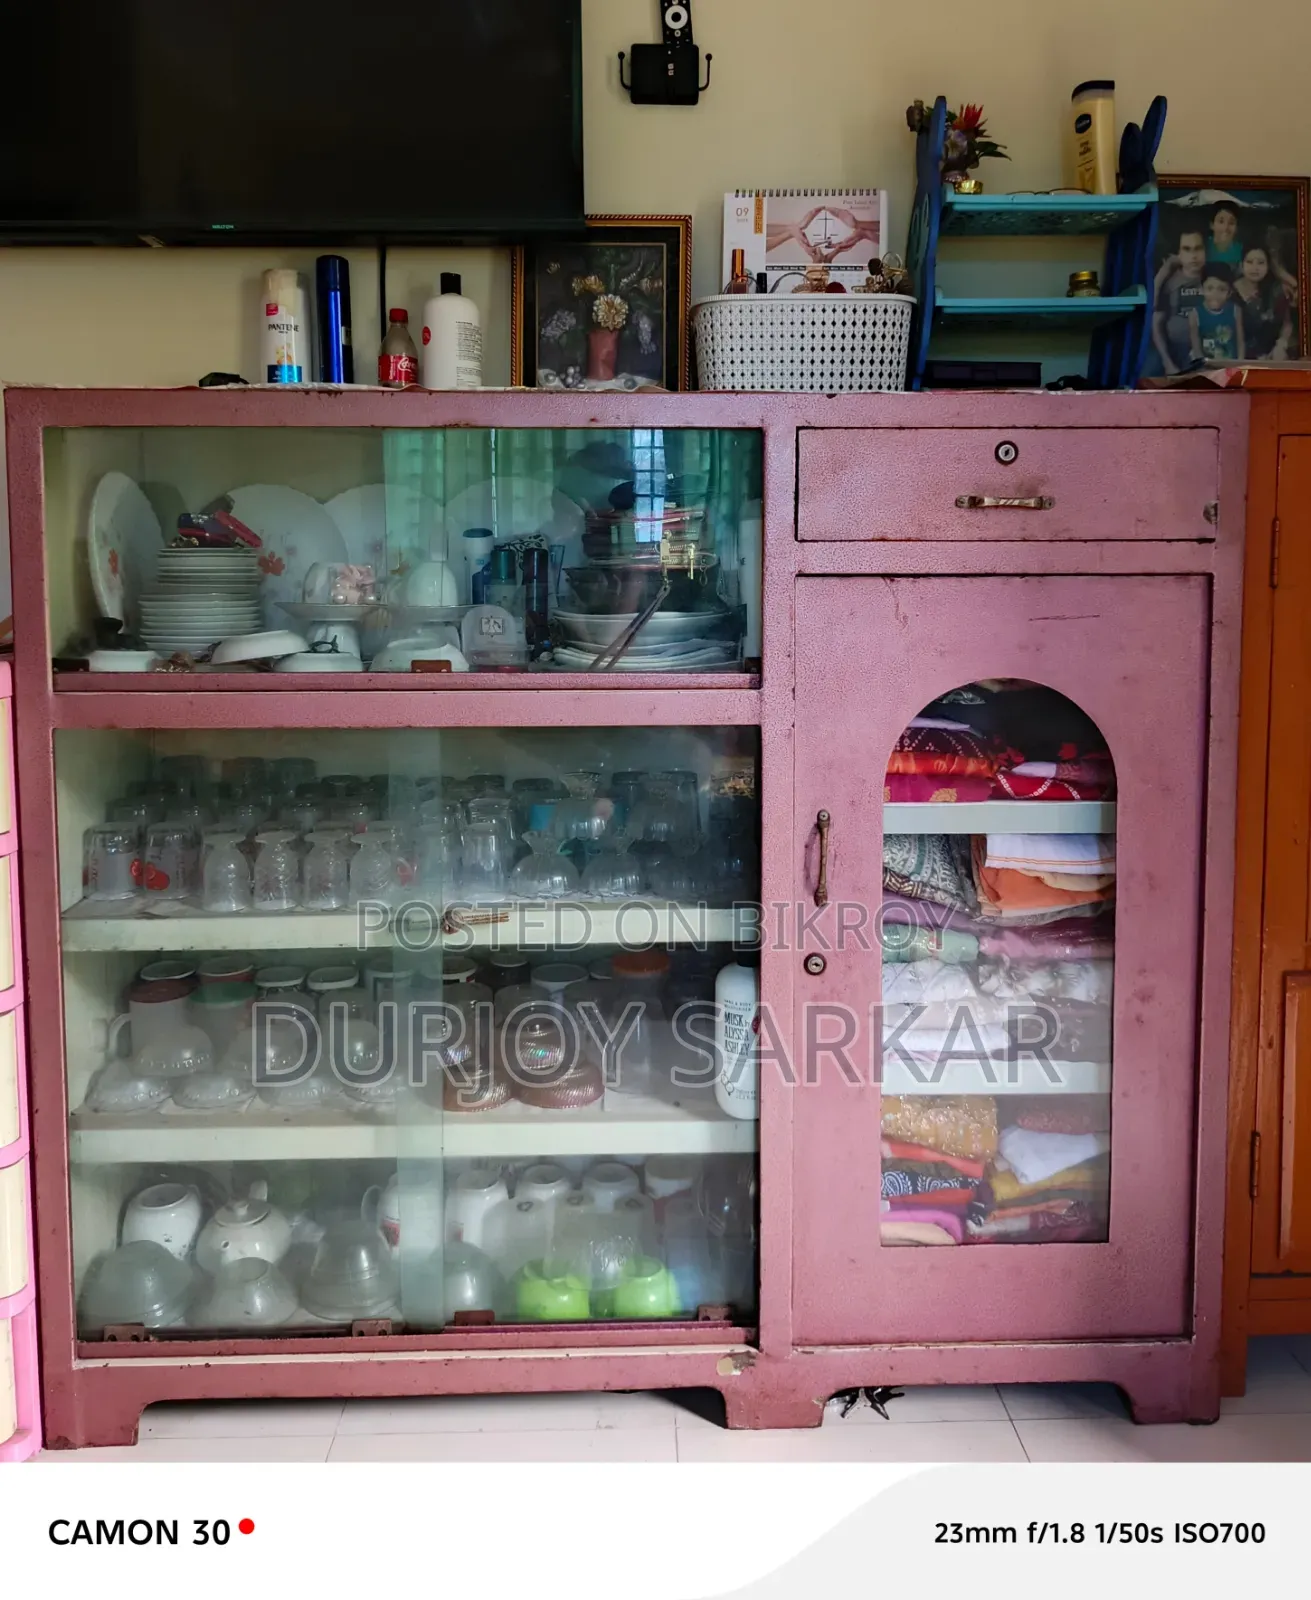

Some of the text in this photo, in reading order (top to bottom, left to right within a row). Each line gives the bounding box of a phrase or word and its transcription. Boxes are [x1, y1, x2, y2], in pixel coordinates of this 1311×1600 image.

[736, 207, 749, 217] 09
[267, 323, 299, 333] PANTENE
[724, 1011, 744, 1028] MUSK
[724, 1024, 749, 1042] ALYSSA
